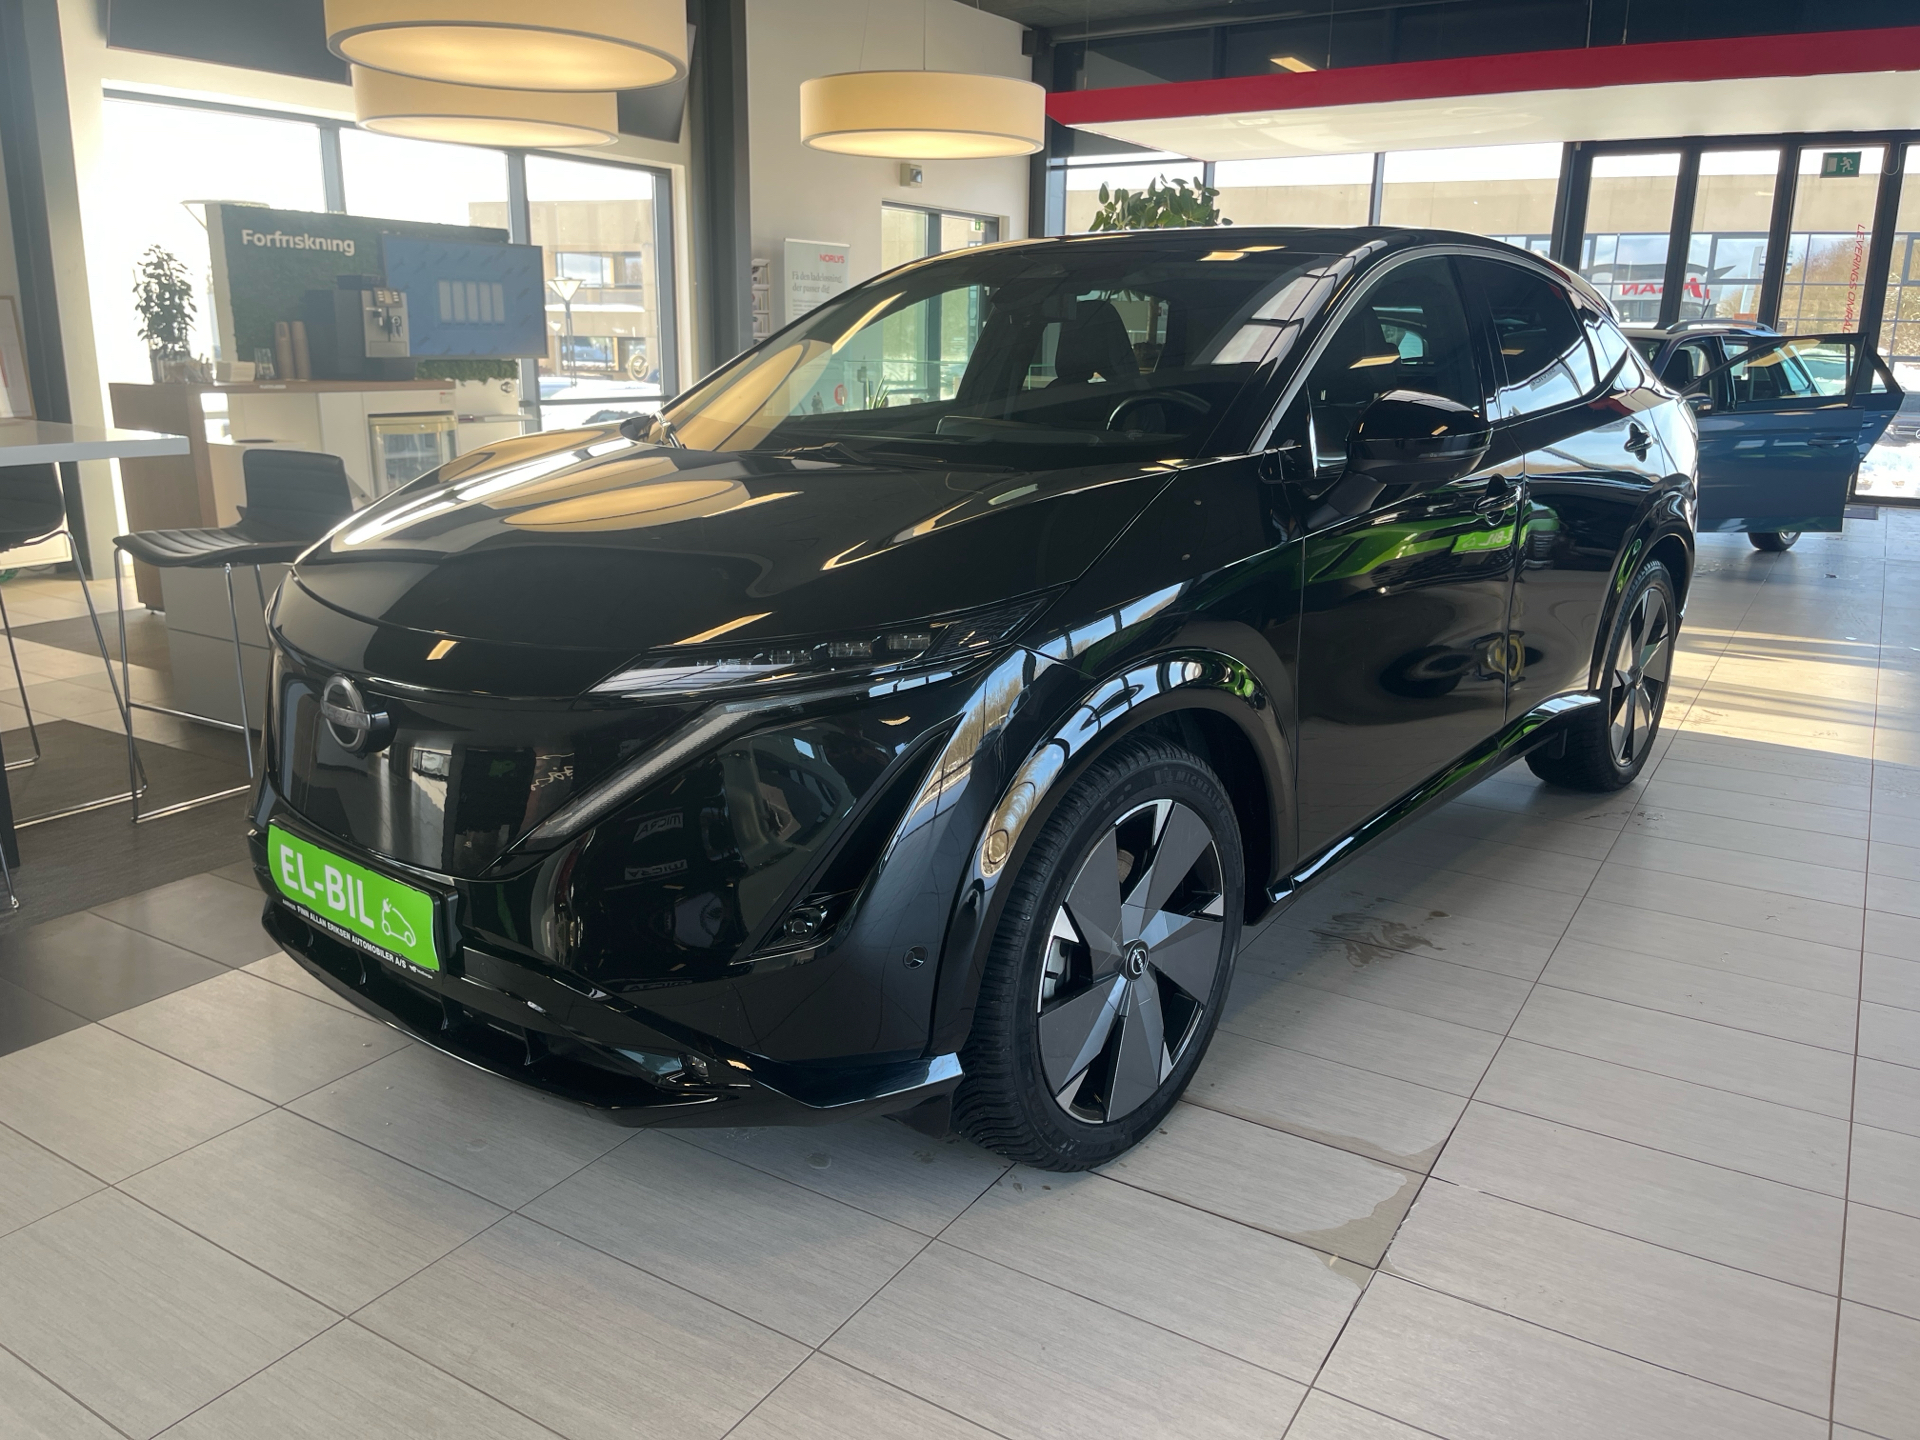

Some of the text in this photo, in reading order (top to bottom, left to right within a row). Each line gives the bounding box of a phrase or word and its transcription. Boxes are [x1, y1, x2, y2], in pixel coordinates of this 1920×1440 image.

[242, 229, 355, 256] Forfriskning
[819, 254, 845, 264] NORLYS
[792, 283, 802, 292] der
[1842, 224, 1865, 333] LEVERINGS OMRÅD
[280, 844, 375, 929] EL-BIL
[297, 906, 407, 969] FINN ALLAN ERIKSEN AUTOMOBILER A/S
